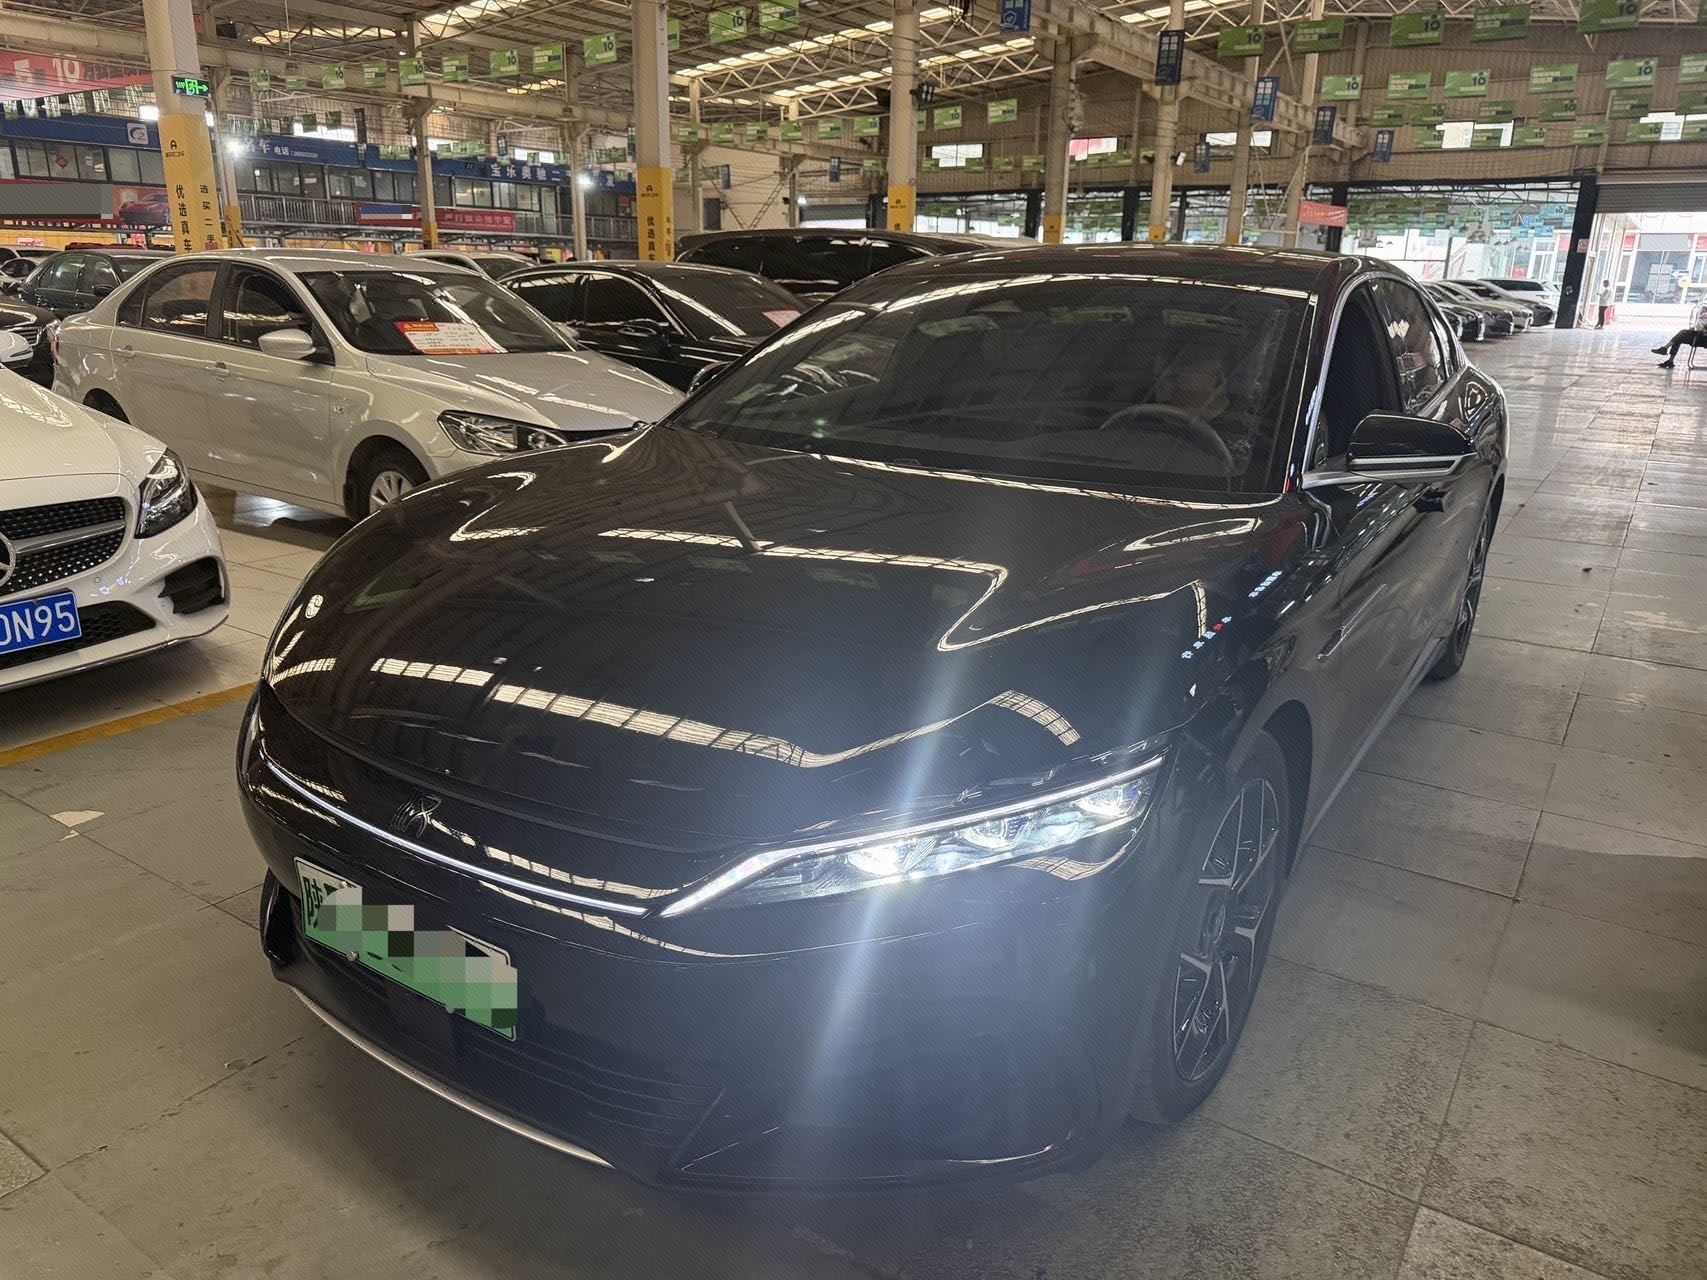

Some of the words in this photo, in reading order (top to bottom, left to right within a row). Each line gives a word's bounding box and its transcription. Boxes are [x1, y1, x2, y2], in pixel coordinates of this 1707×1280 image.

[1620, 2, 1638, 16] 10
[1424, 20, 1440, 31] 10
[604, 41, 614, 51] 10
[507, 56, 517, 65] 10
[52, 54, 80, 86] 10
[1638, 66, 1653, 76] 10
[1347, 81, 1359, 91] 10
[1473, 76, 1486, 86] 10
[175, 183, 193, 253] 优选真车
